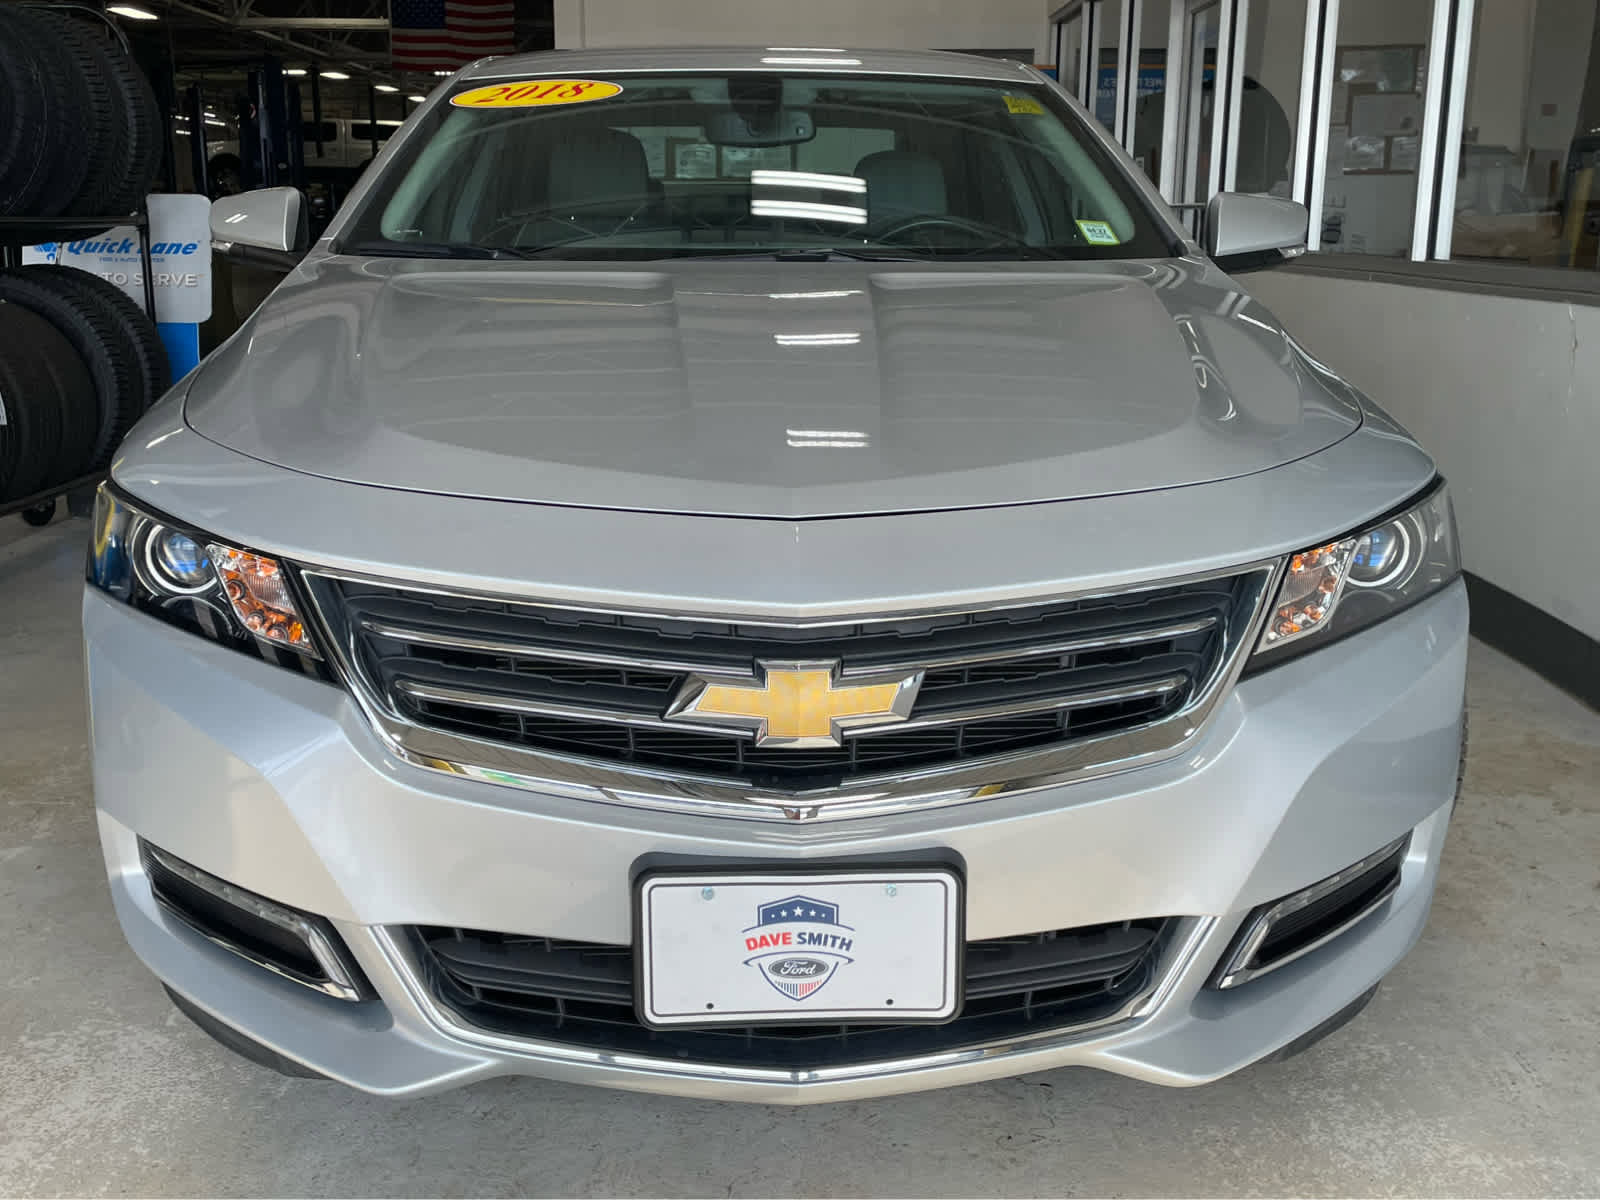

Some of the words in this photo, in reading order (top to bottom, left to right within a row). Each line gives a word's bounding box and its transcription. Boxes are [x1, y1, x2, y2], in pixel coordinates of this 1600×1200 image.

[473, 83, 594, 104] 2018
[67, 238, 134, 255] Quick
[137, 241, 198, 255] ane
[134, 272, 197, 287] SRVE
[745, 932, 792, 951] DAVE
[797, 932, 853, 952] SMITH
[780, 960, 818, 975] Ford
